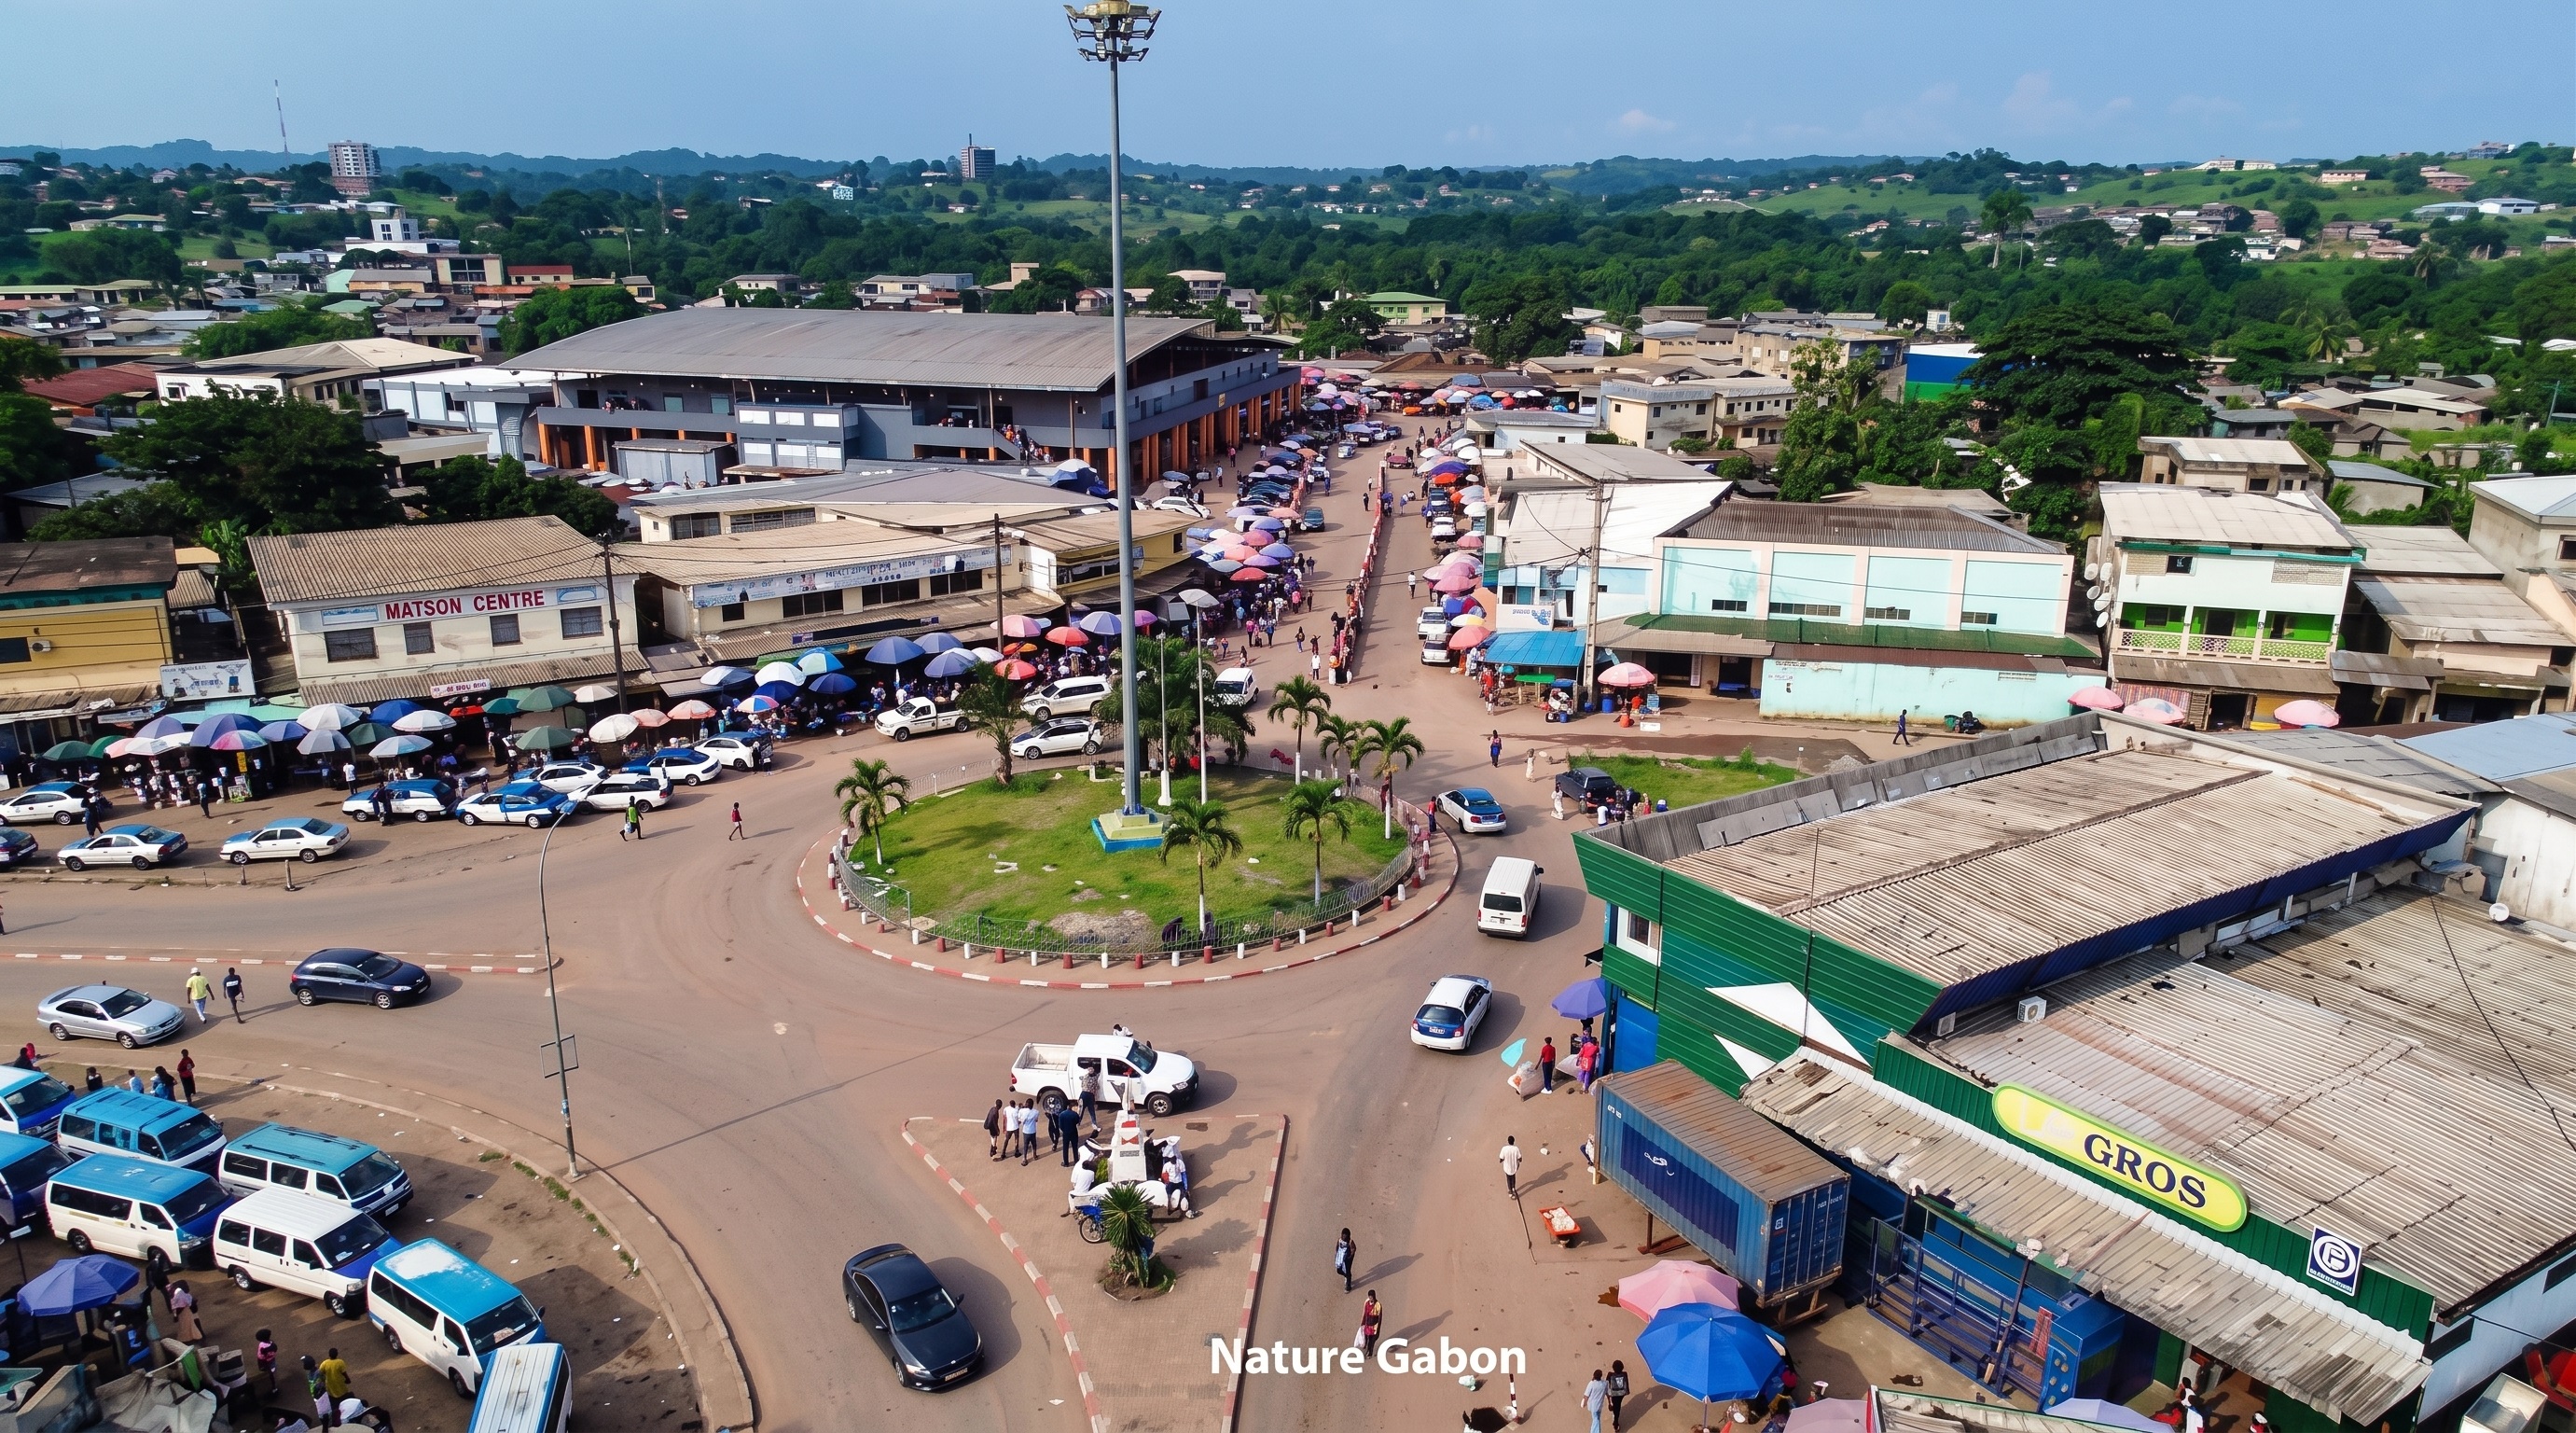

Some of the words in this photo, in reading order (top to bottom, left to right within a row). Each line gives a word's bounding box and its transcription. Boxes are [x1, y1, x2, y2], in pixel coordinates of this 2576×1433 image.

[385, 597, 462, 619] MATSON
[473, 590, 545, 611] CENTRE
[2084, 1134, 2206, 1208] GROS
